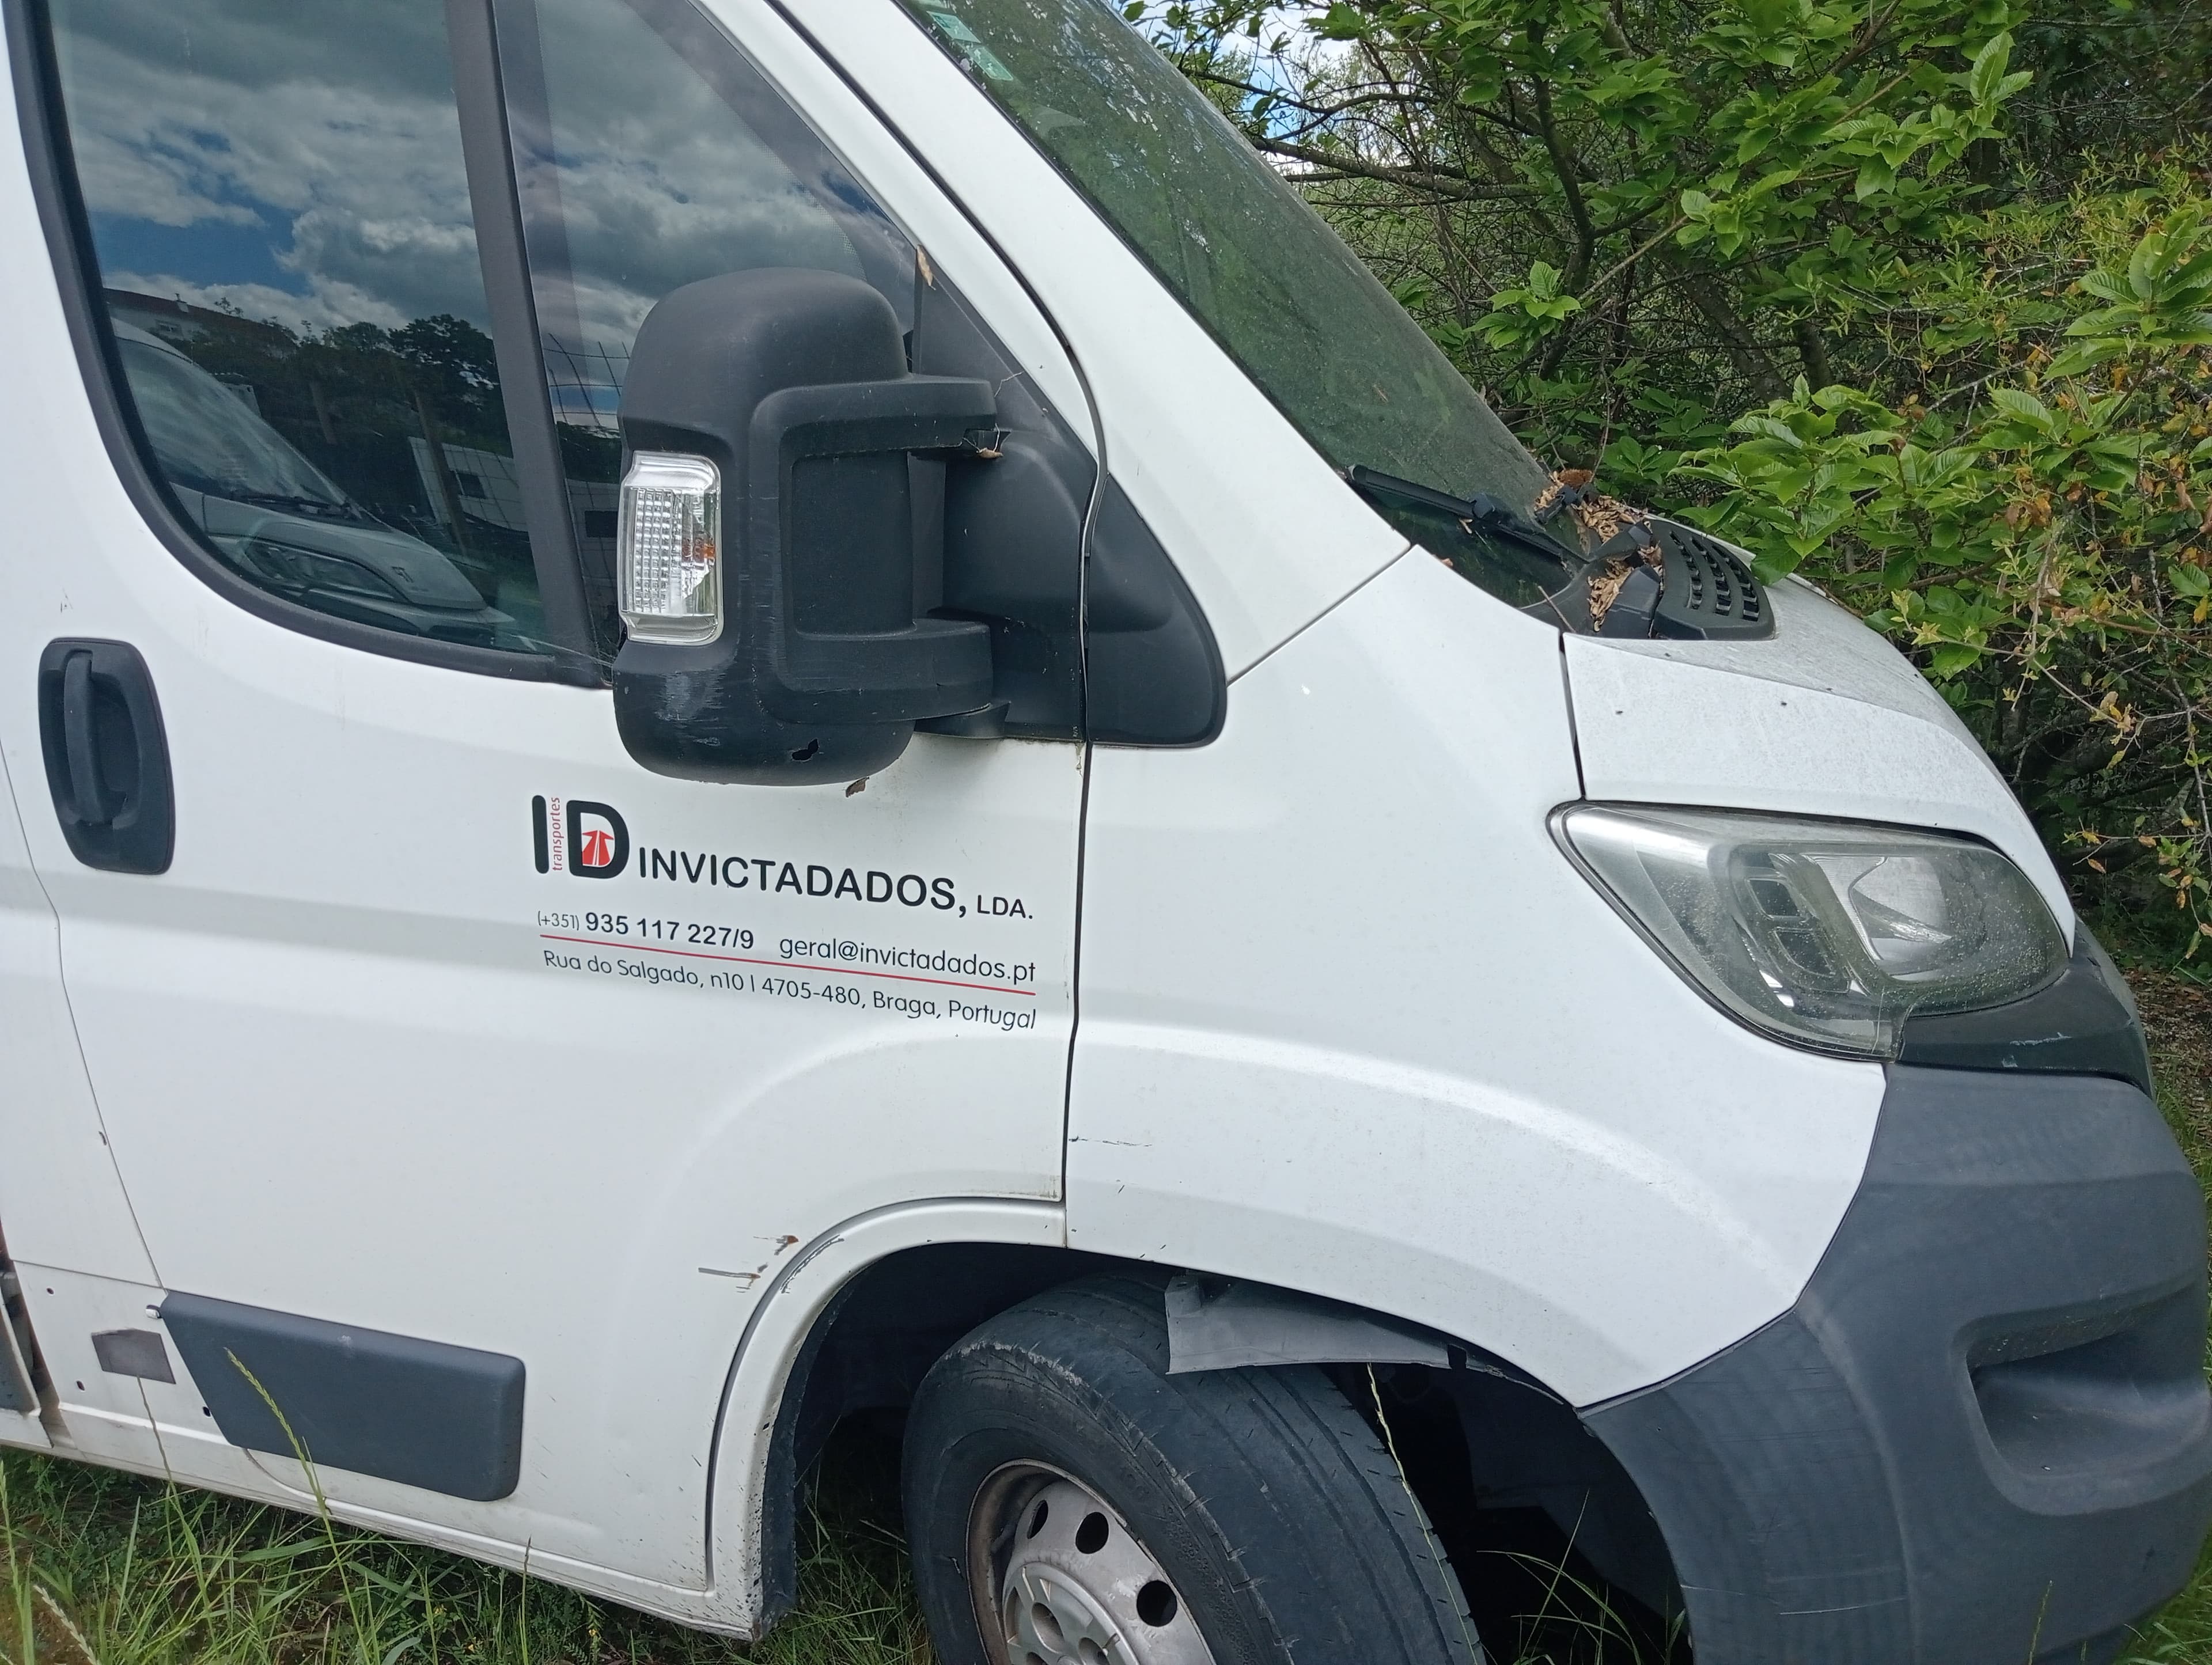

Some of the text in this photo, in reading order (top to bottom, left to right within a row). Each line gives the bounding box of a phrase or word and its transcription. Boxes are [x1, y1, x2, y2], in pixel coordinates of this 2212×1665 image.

[550, 797, 565, 871] transportes
[639, 847, 1034, 920] INVICTADADOS, LDA.
[537, 910, 1037, 985] (+351) 935 117 227/9 geral@invictadados.pt
[543, 950, 582, 970] Rua
[587, 954, 612, 974] do
[617, 959, 704, 989] Salgado,
[710, 972, 745, 991] n10
[762, 977, 866, 1010] 4705-480,
[872, 991, 942, 1021] Braga,
[948, 999, 1037, 1031] Portugal
